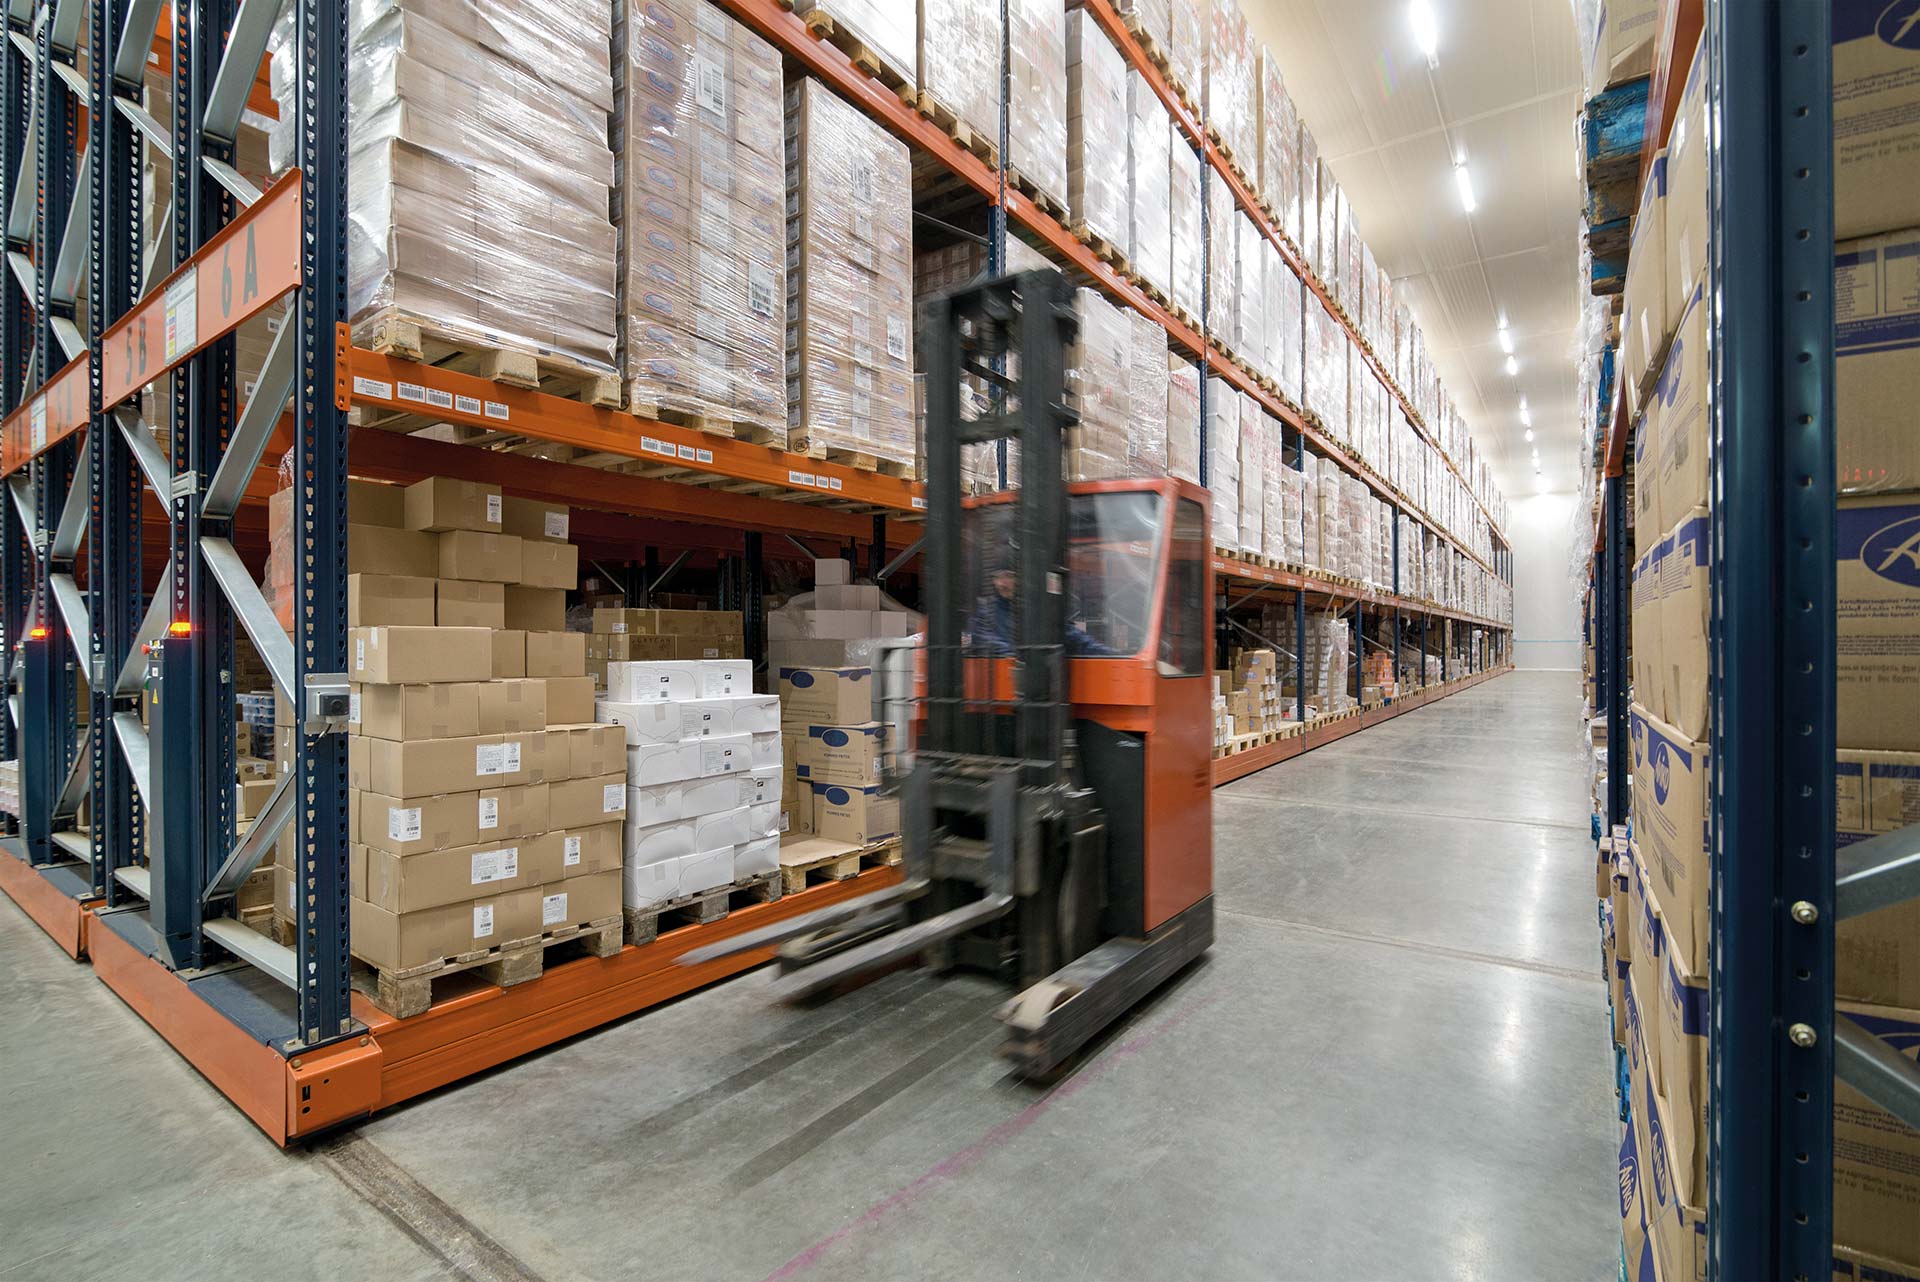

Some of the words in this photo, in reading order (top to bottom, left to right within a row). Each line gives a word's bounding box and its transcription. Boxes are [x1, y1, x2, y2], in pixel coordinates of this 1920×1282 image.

[222, 243, 232, 318] 6
[243, 222, 258, 305] A
[125, 326, 132, 386] 5
[138, 314, 147, 376] B
